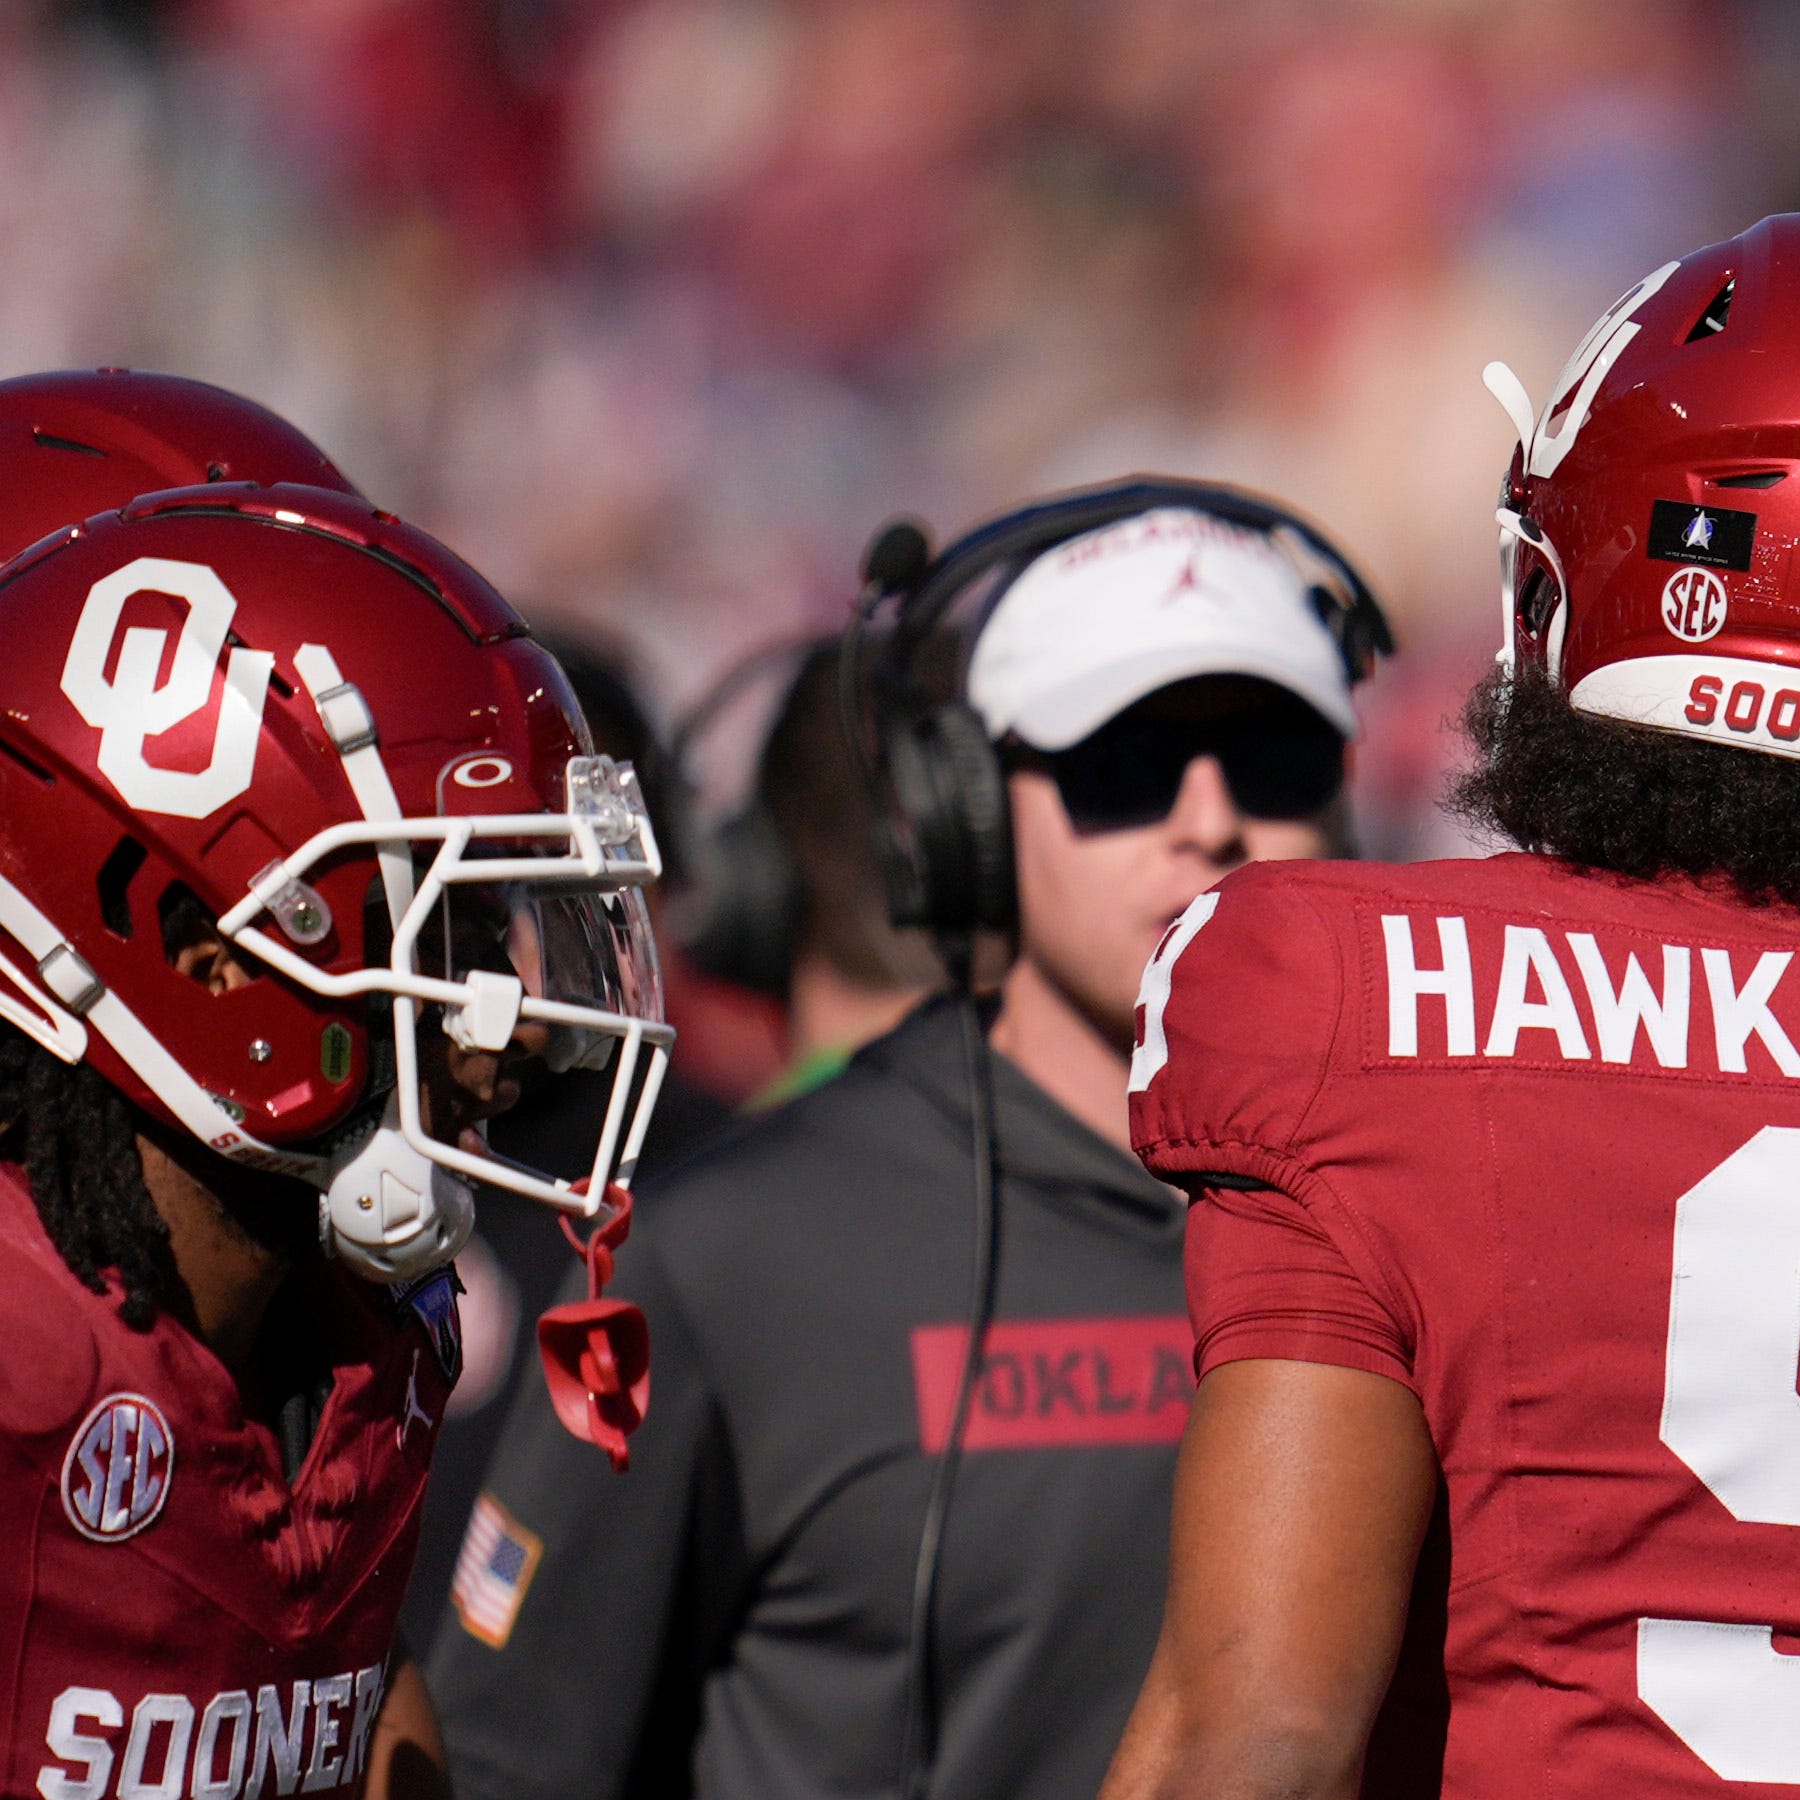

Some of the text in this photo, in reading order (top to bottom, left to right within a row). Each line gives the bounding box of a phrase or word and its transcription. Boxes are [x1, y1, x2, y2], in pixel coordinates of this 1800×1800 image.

[1667, 571, 1721, 638] SEC
[60, 556, 274, 819] OU
[72, 1404, 166, 1532] SEC
